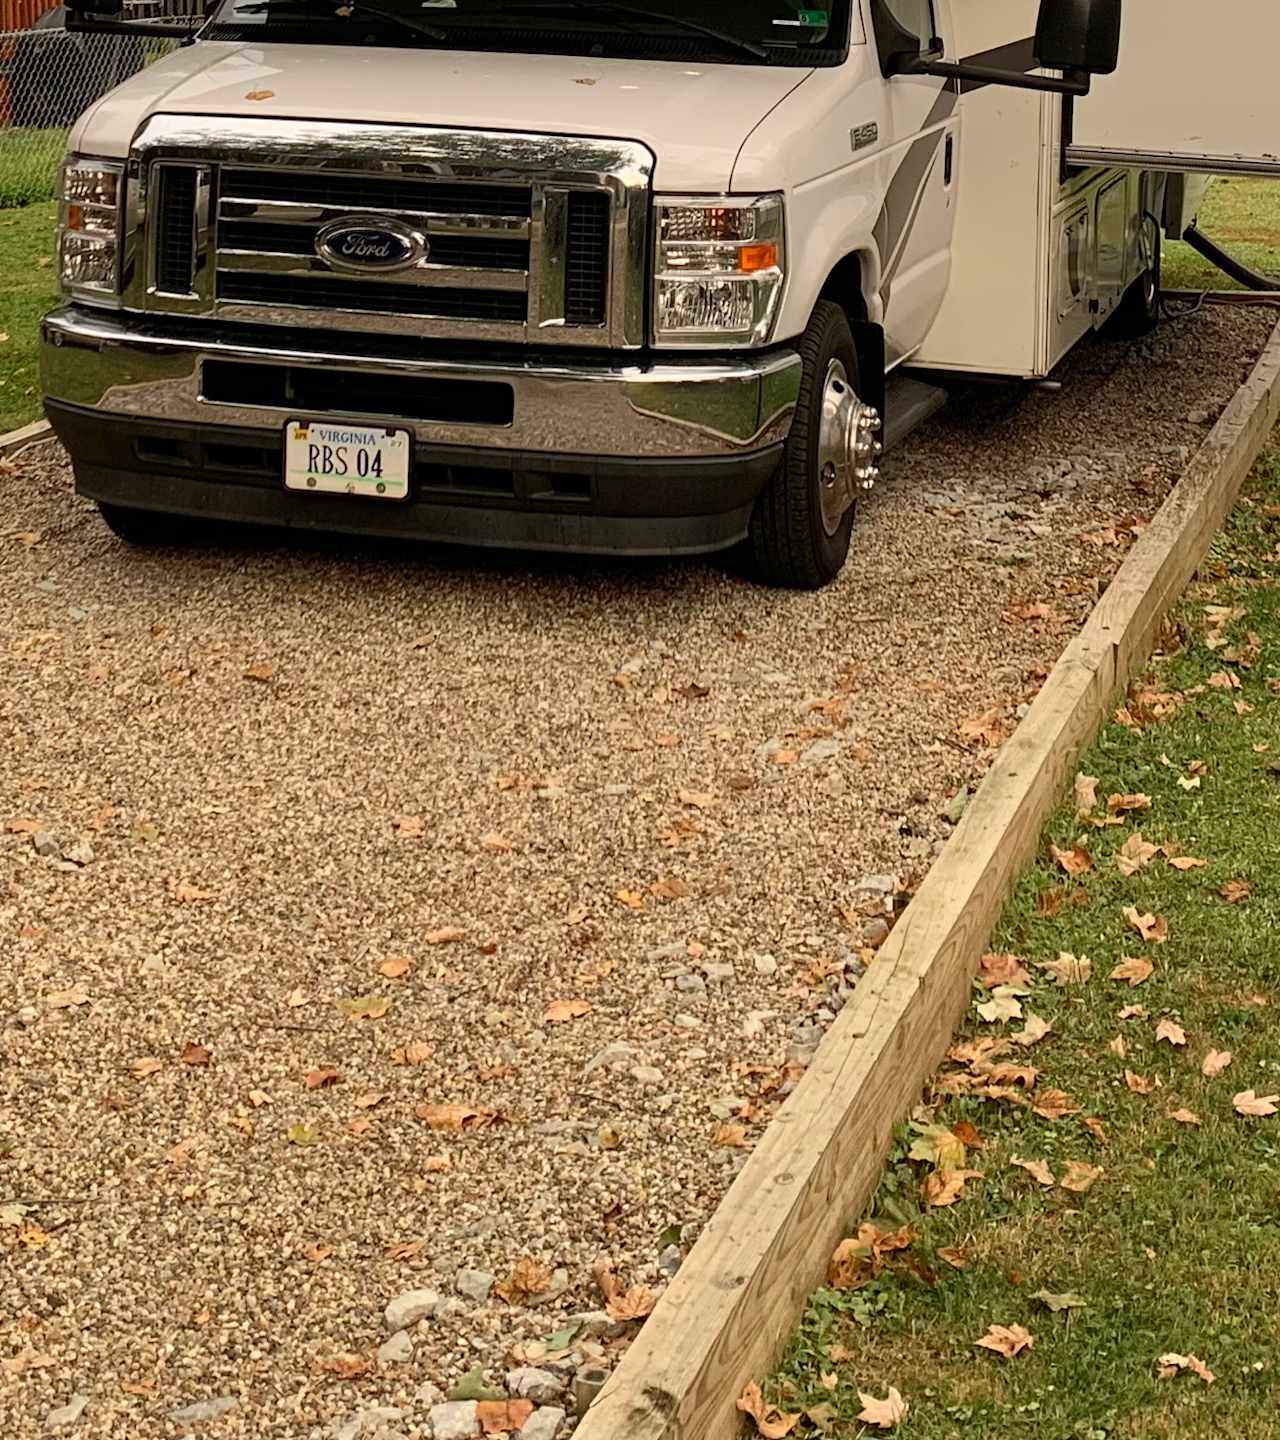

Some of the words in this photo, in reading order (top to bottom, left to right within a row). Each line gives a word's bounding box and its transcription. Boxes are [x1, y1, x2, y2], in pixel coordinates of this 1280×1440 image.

[342, 233, 391, 257] Ford
[319, 429, 376, 446] VIRGINIA
[308, 443, 348, 476] RBS
[357, 448, 383, 479] 04
